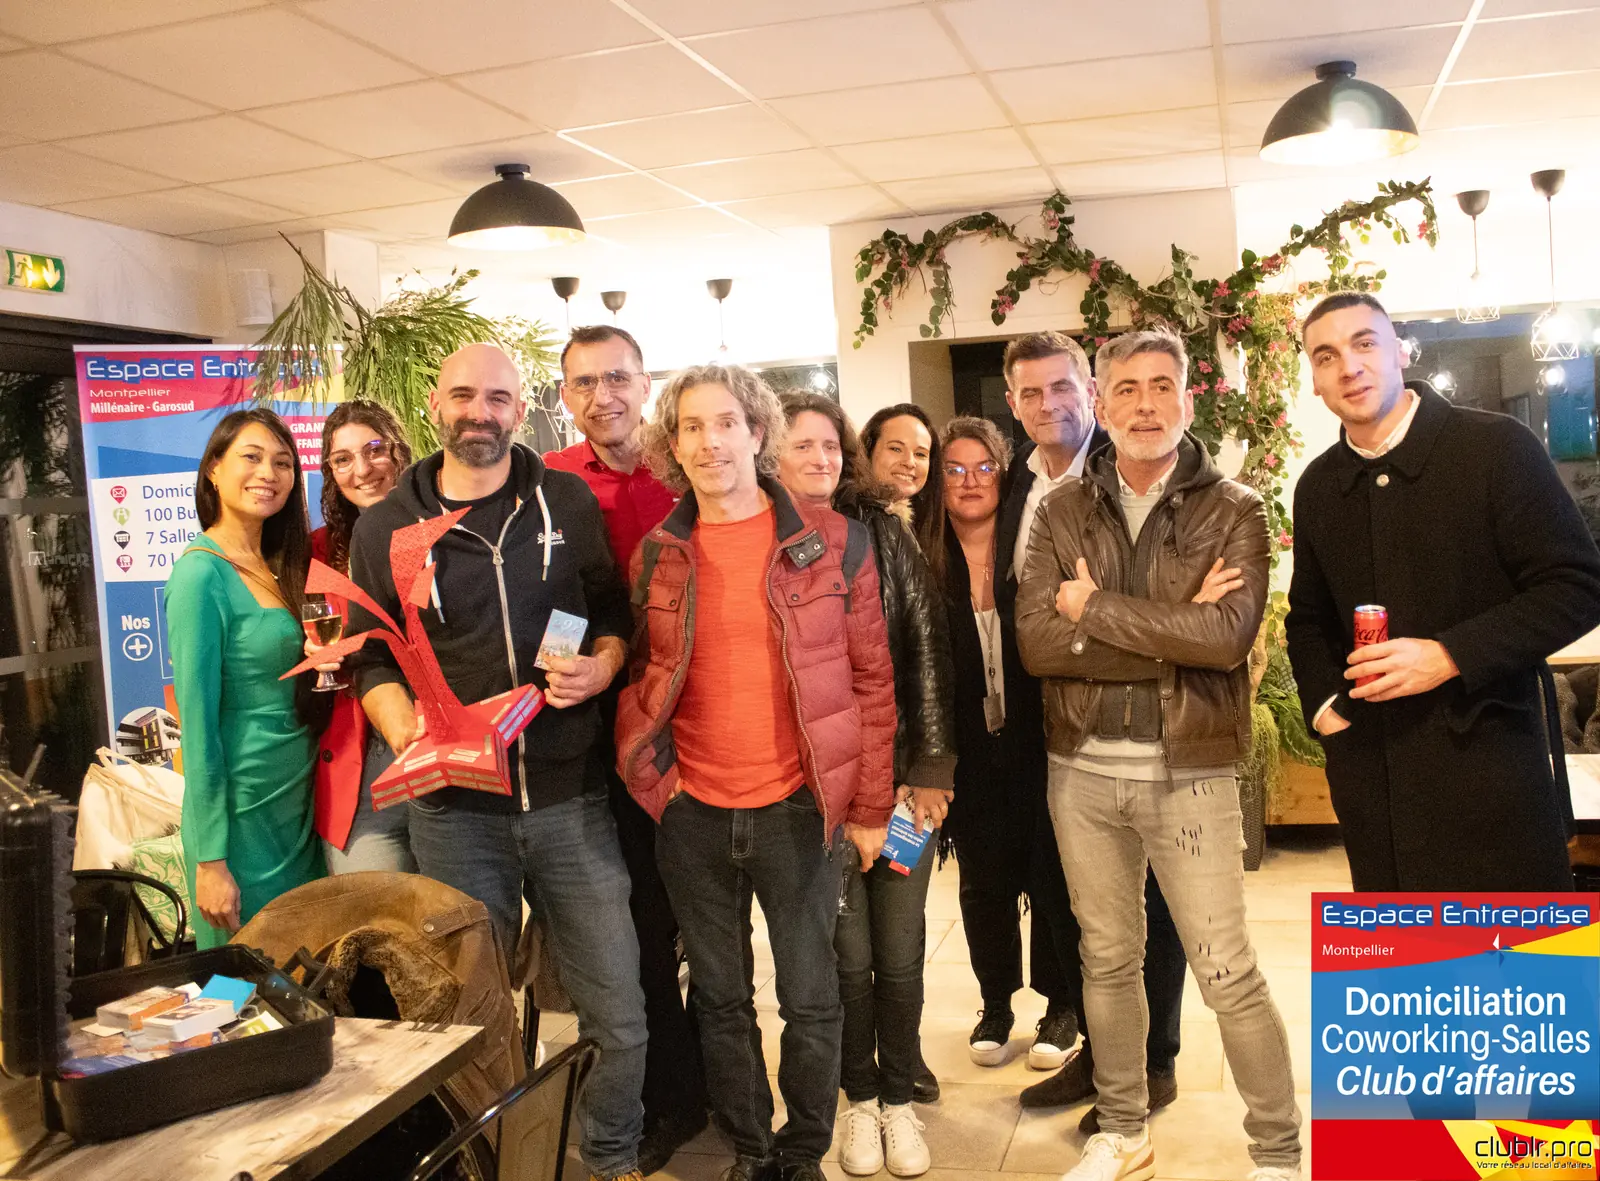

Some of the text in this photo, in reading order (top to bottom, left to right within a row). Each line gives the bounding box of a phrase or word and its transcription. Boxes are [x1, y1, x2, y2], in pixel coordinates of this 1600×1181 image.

[86, 360, 194, 381] Espace
[89, 389, 171, 398] Montpellier
[90, 402, 145, 414] Millénaire
[152, 400, 195, 412] Garosud
[144, 507, 172, 521] 100
[145, 531, 154, 545] 7
[147, 553, 167, 567] 70
[121, 615, 150, 631] Nos
